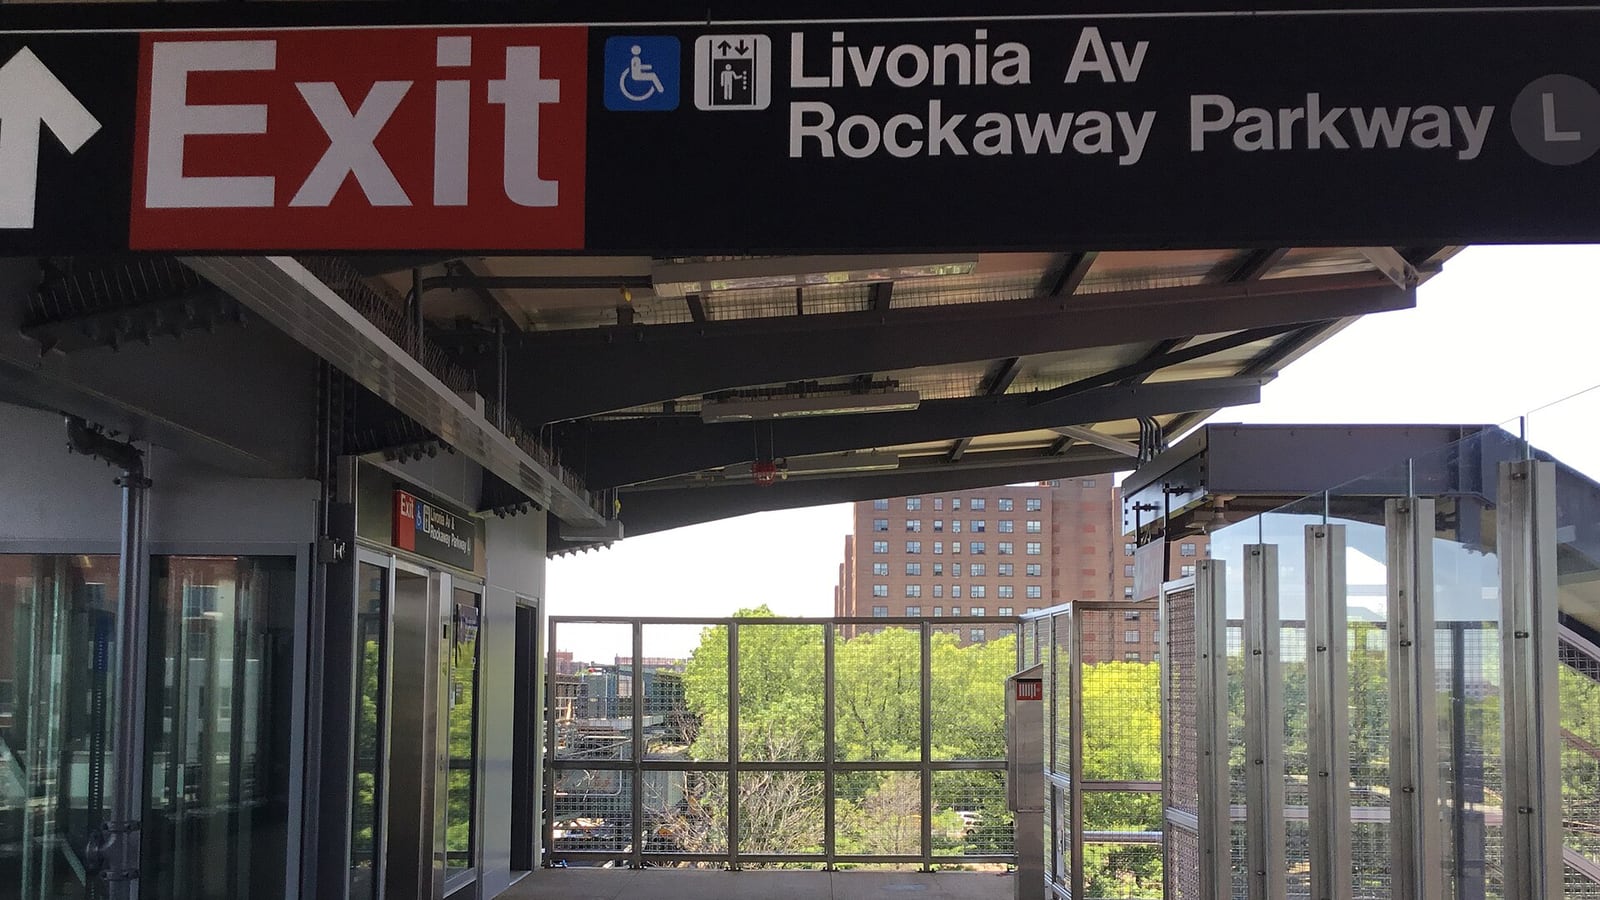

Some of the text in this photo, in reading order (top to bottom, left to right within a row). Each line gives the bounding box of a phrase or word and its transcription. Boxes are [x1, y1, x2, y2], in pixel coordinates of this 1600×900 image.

[790, 26, 1150, 88] Livonia Av
[145, 36, 560, 208] Exit
[789, 92, 1581, 166] Rockaway Parkway L
[400, 493, 414, 519] Exit
[430, 524, 451, 548] Rockaway
